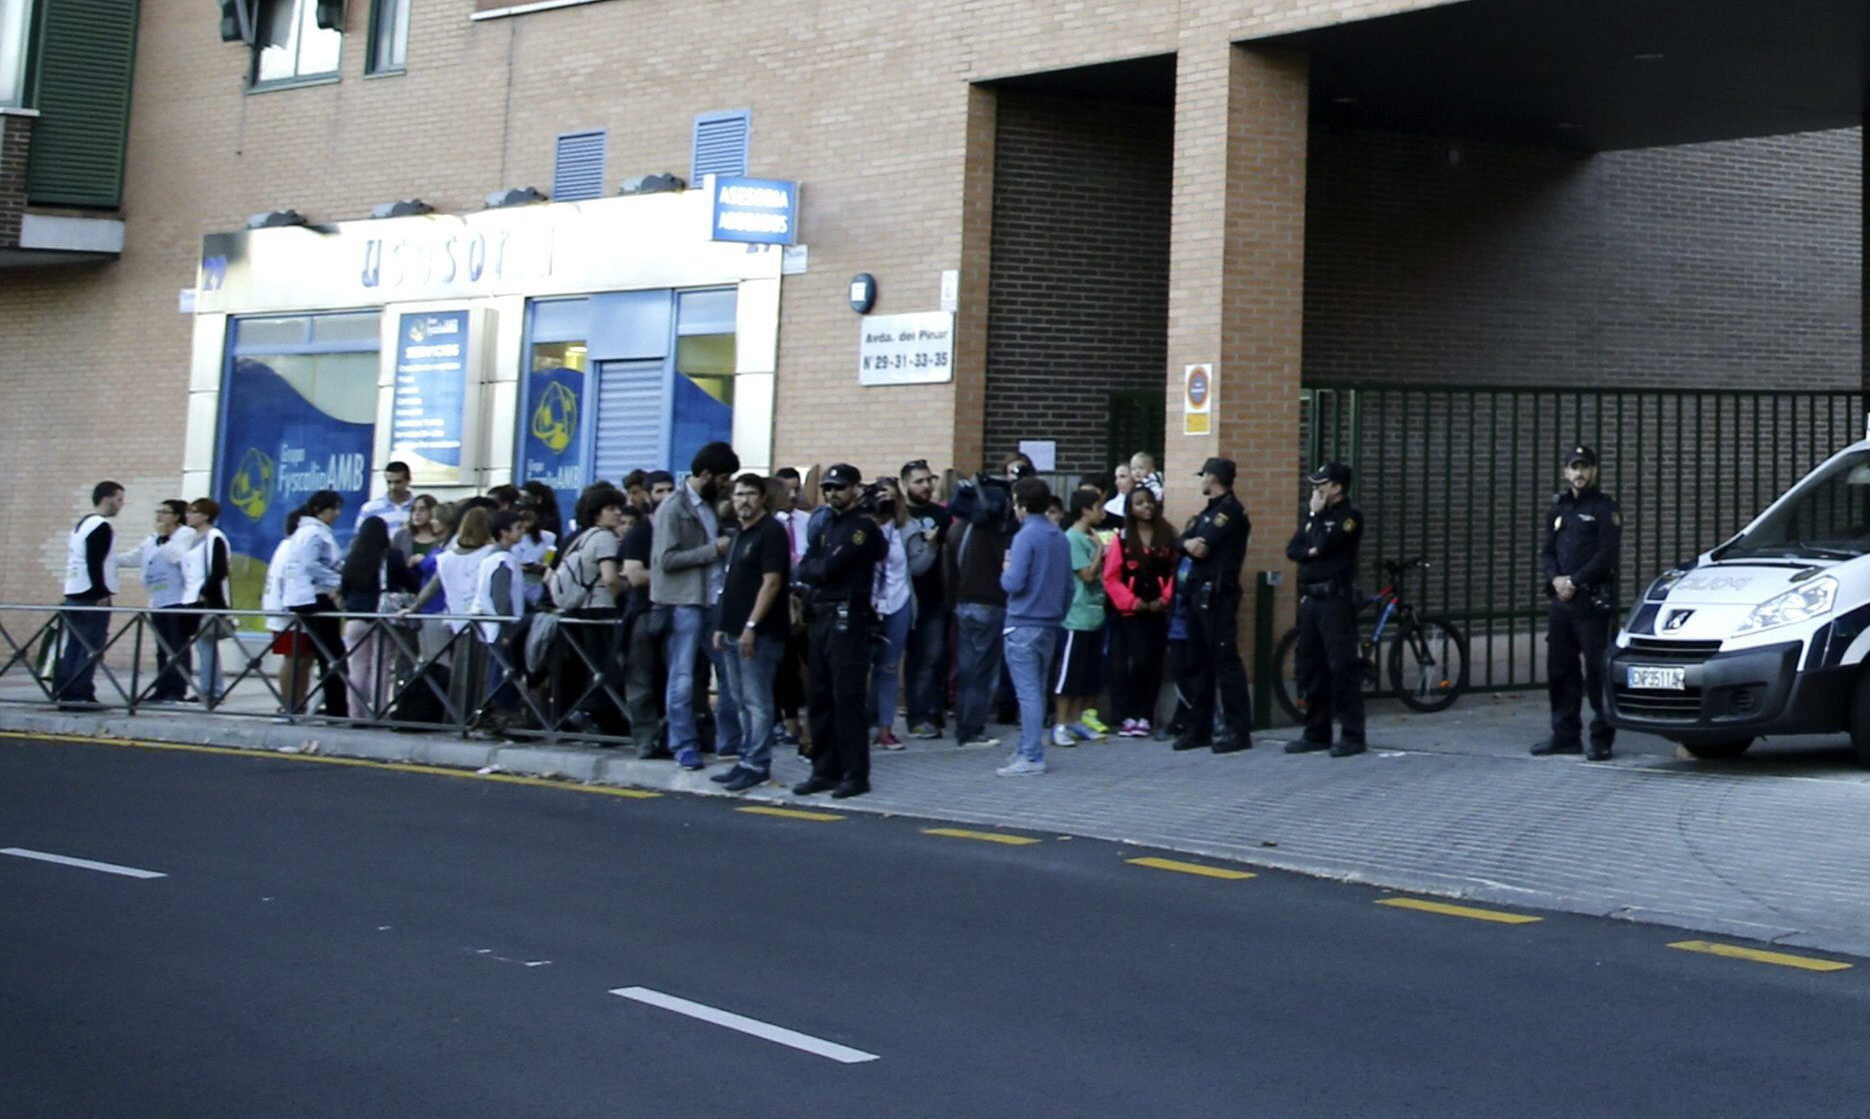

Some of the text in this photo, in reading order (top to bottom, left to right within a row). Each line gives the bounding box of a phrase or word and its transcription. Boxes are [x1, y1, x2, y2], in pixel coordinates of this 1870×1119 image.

[865, 330, 949, 343] Avda. del Pinar
